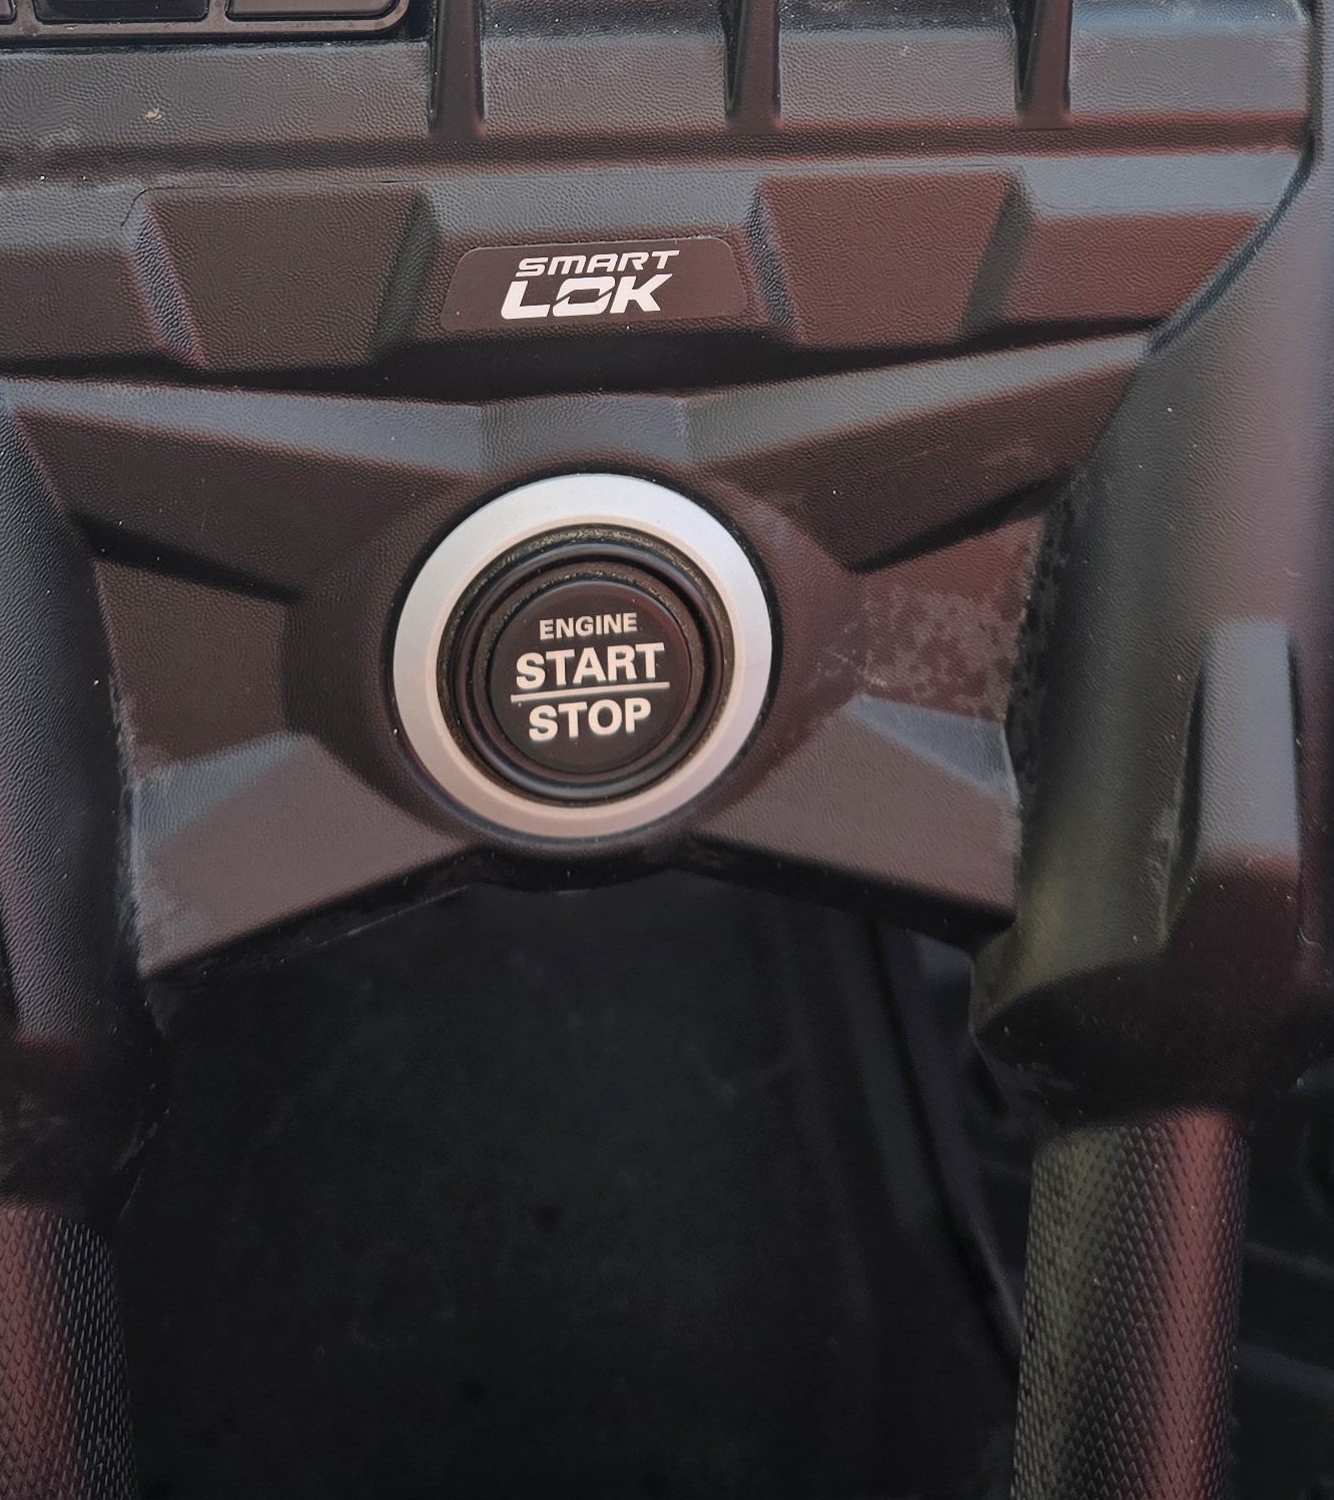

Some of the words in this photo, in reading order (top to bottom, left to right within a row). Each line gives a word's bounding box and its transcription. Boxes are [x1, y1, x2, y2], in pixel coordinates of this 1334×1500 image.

[514, 249, 680, 277] SMART
[500, 273, 673, 320] LOK
[539, 612, 638, 641] ENGINE
[515, 642, 666, 689] START
[528, 698, 652, 742] STOP
